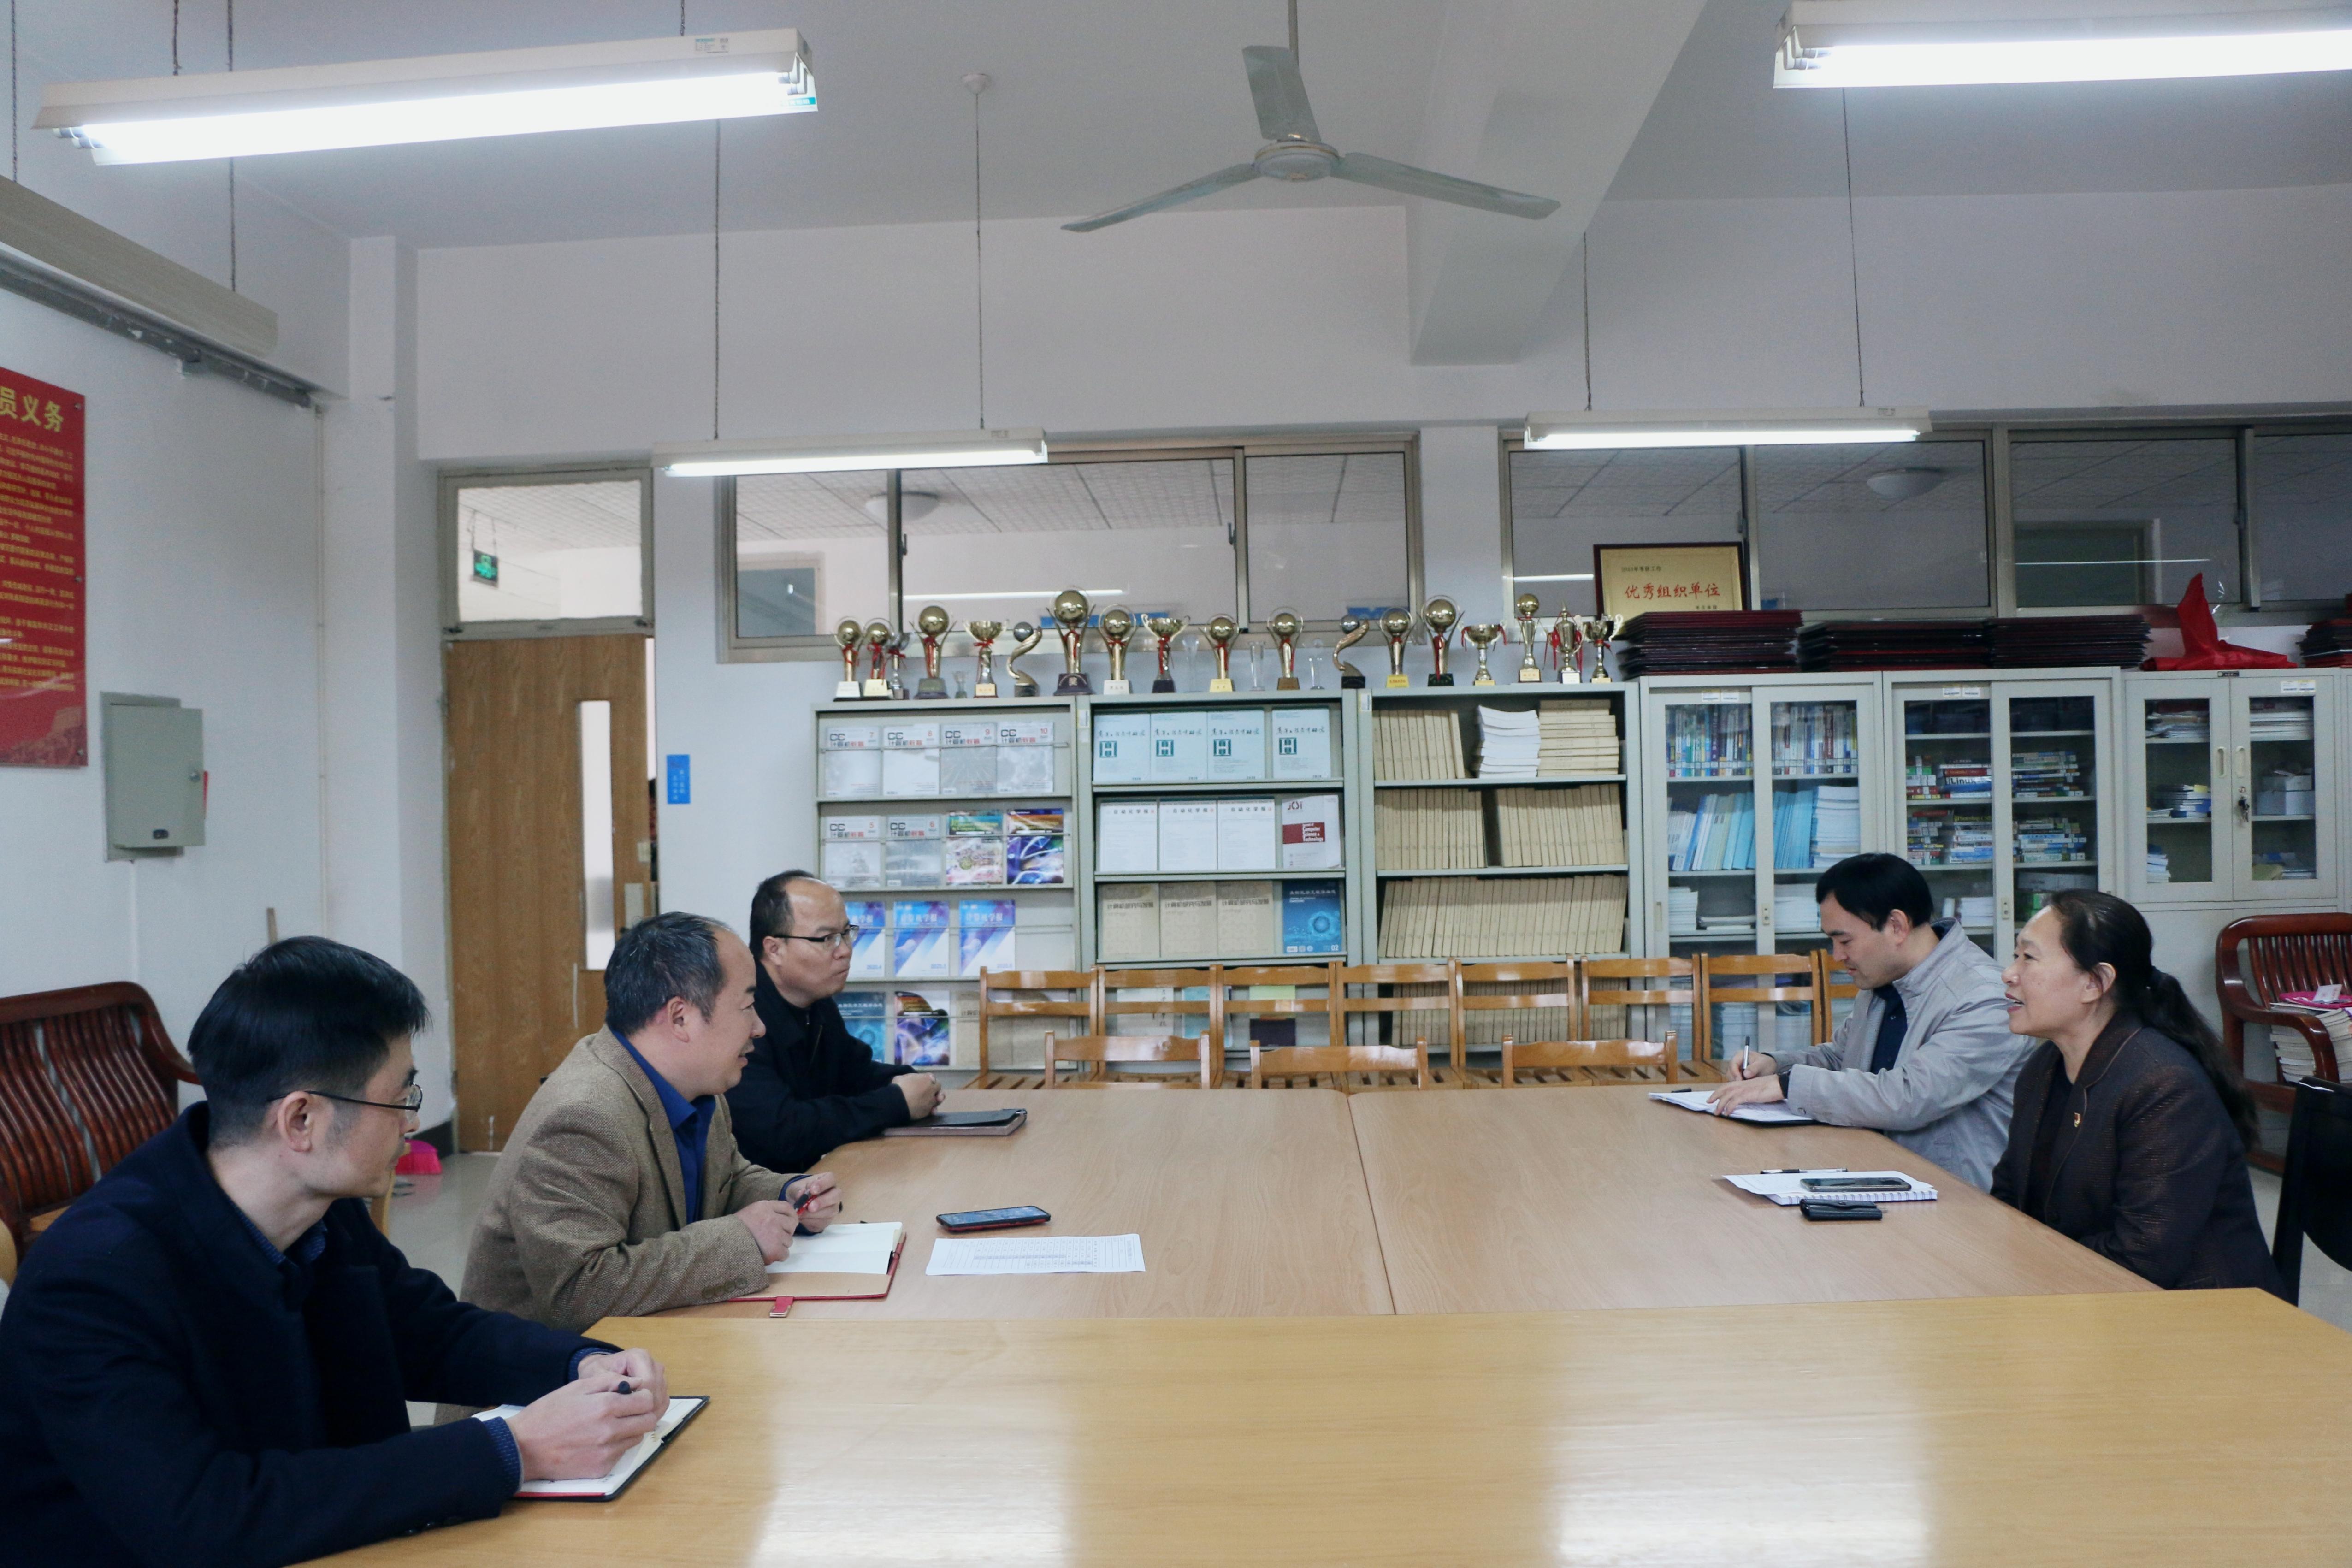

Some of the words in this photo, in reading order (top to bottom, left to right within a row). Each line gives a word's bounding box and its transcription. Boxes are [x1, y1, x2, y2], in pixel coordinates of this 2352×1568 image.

[1625, 582, 1720, 600] 优秀组织单位
